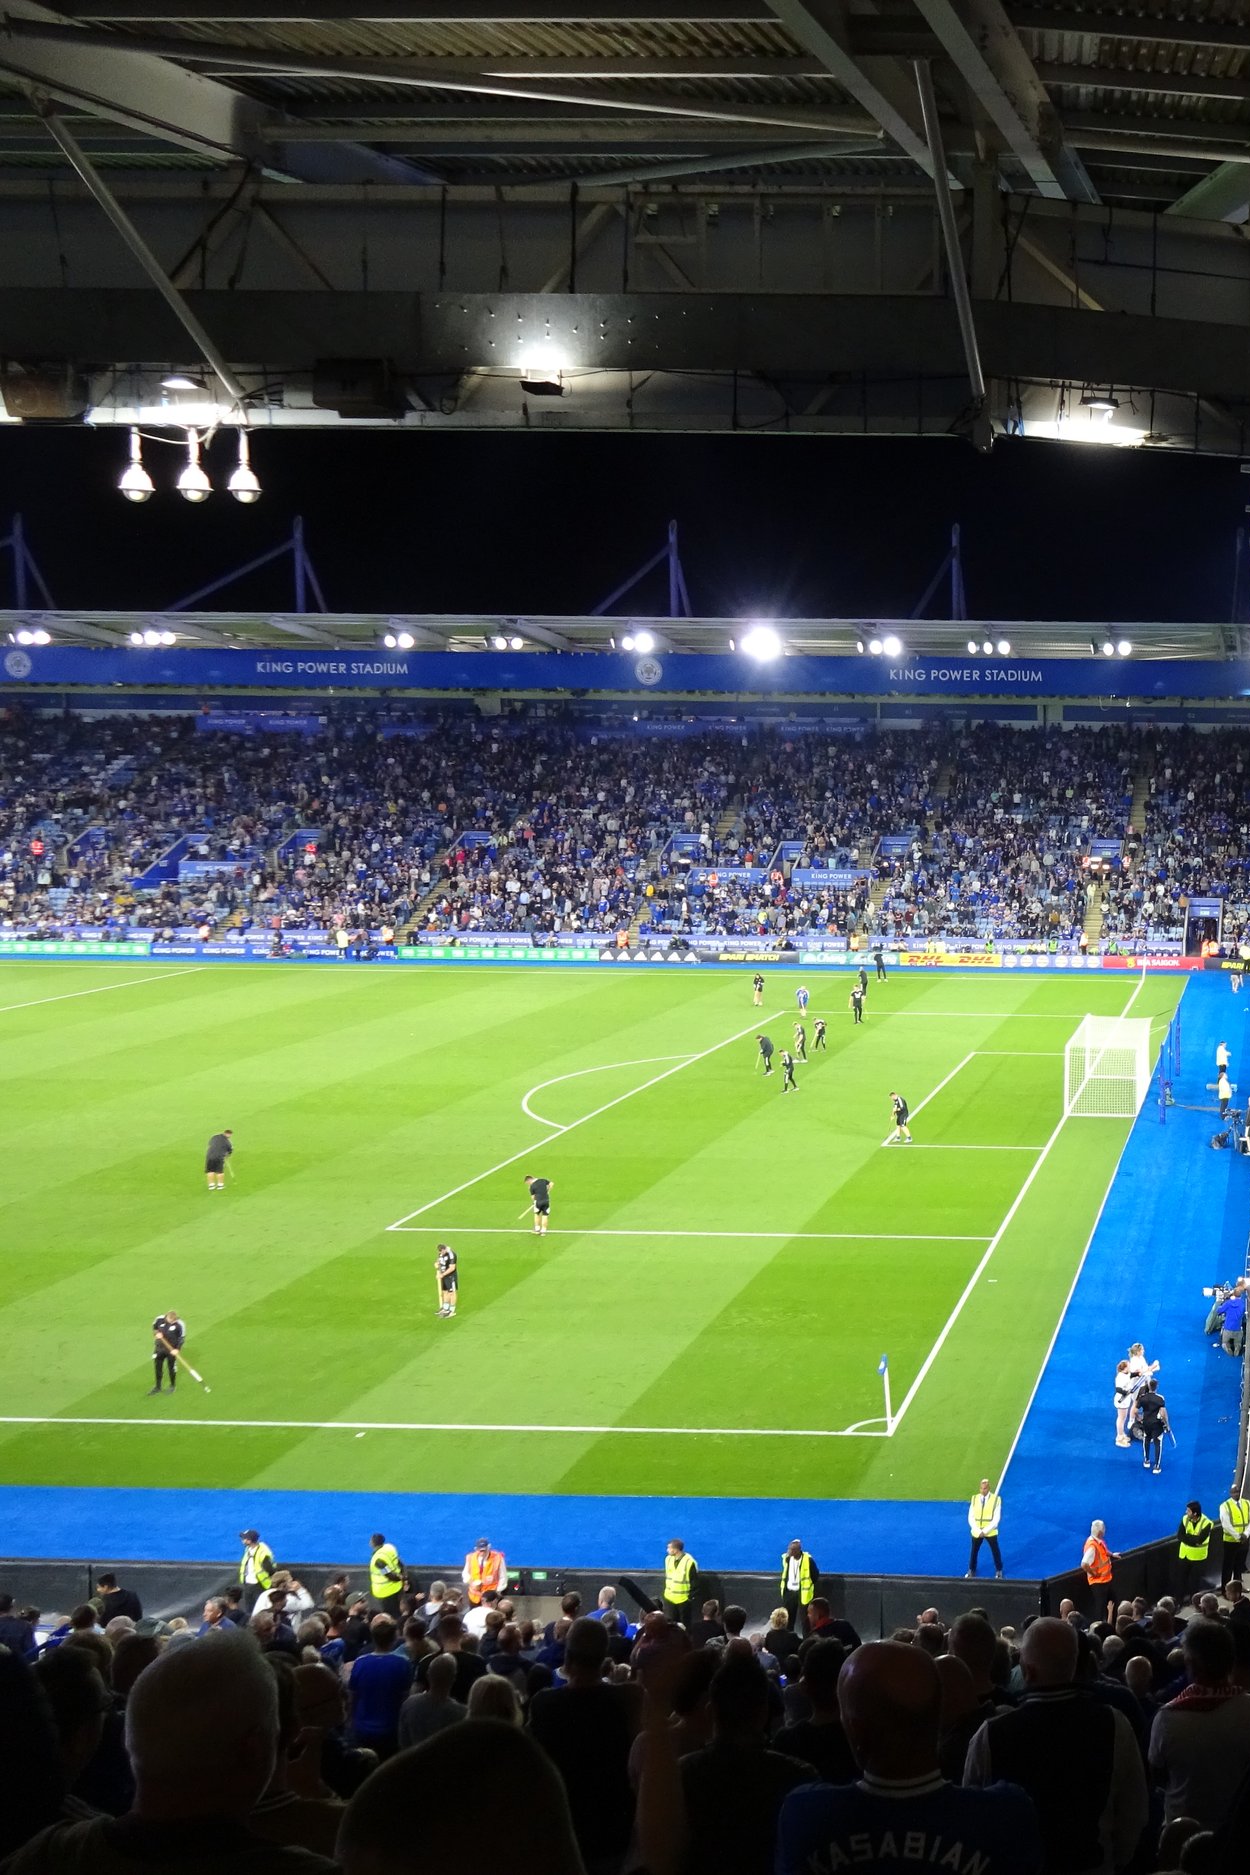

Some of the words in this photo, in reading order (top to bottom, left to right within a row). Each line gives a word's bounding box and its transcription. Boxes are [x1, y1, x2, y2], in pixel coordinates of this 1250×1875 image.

[256, 661, 294, 674] KING
[297, 662, 347, 675] POWER
[351, 662, 409, 675] STADIUM
[889, 669, 927, 681] KING
[930, 669, 981, 682] POWER
[984, 670, 1043, 682] STADIUM
[302, 949, 320, 957] KING
[816, 952, 848, 964] Chang
[908, 955, 944, 964] DHL
[958, 956, 996, 965] DHL
[806, 1831, 992, 1875] KASABIAN
